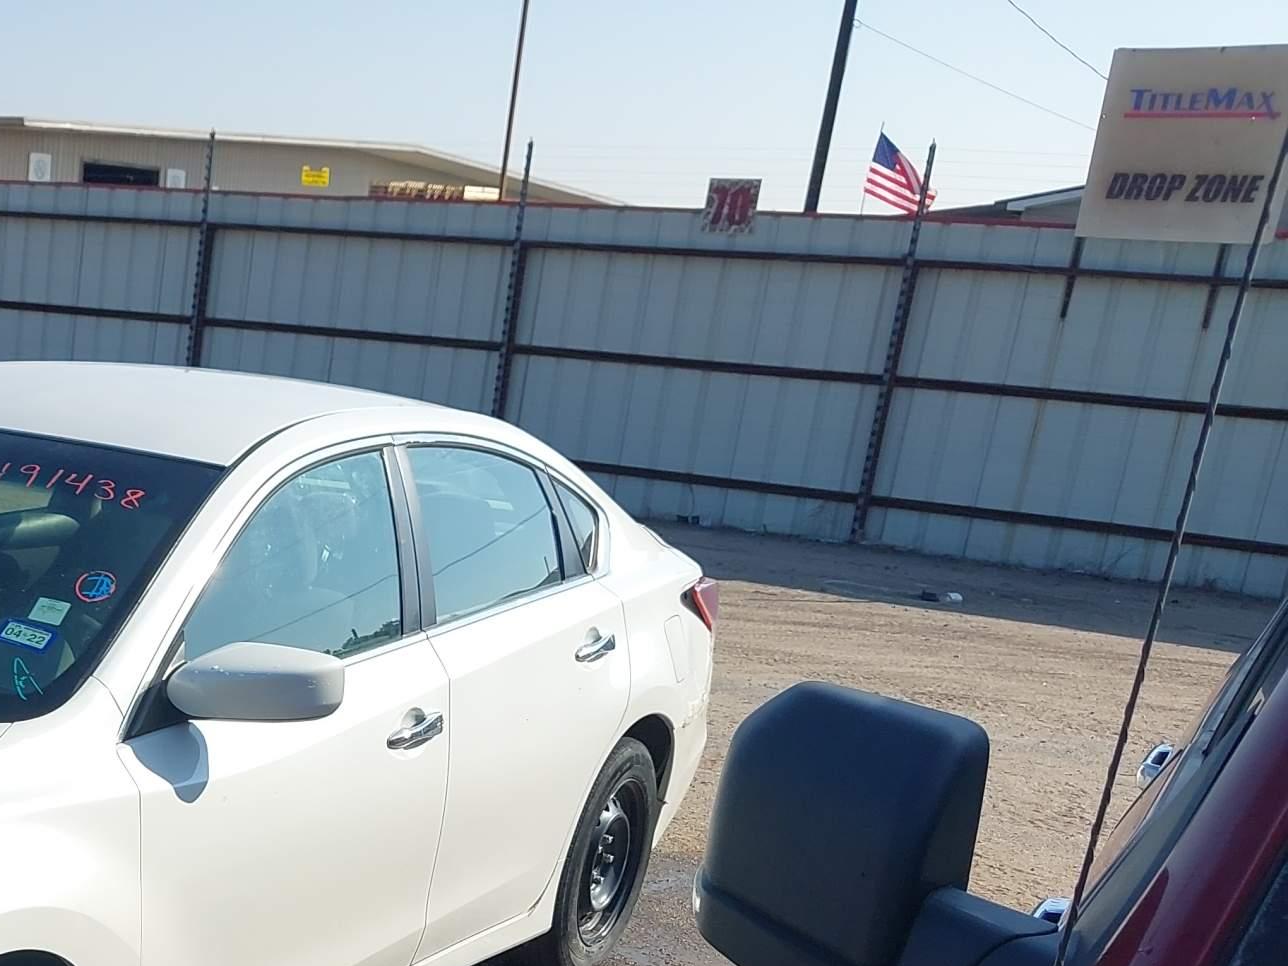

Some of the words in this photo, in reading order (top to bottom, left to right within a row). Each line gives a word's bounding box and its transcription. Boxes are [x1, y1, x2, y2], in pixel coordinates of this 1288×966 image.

[1105, 173, 1187, 201] DROP
[1184, 174, 1265, 203] ZONE
[4, 626, 23, 639] 04
[25, 633, 47, 646] 22
